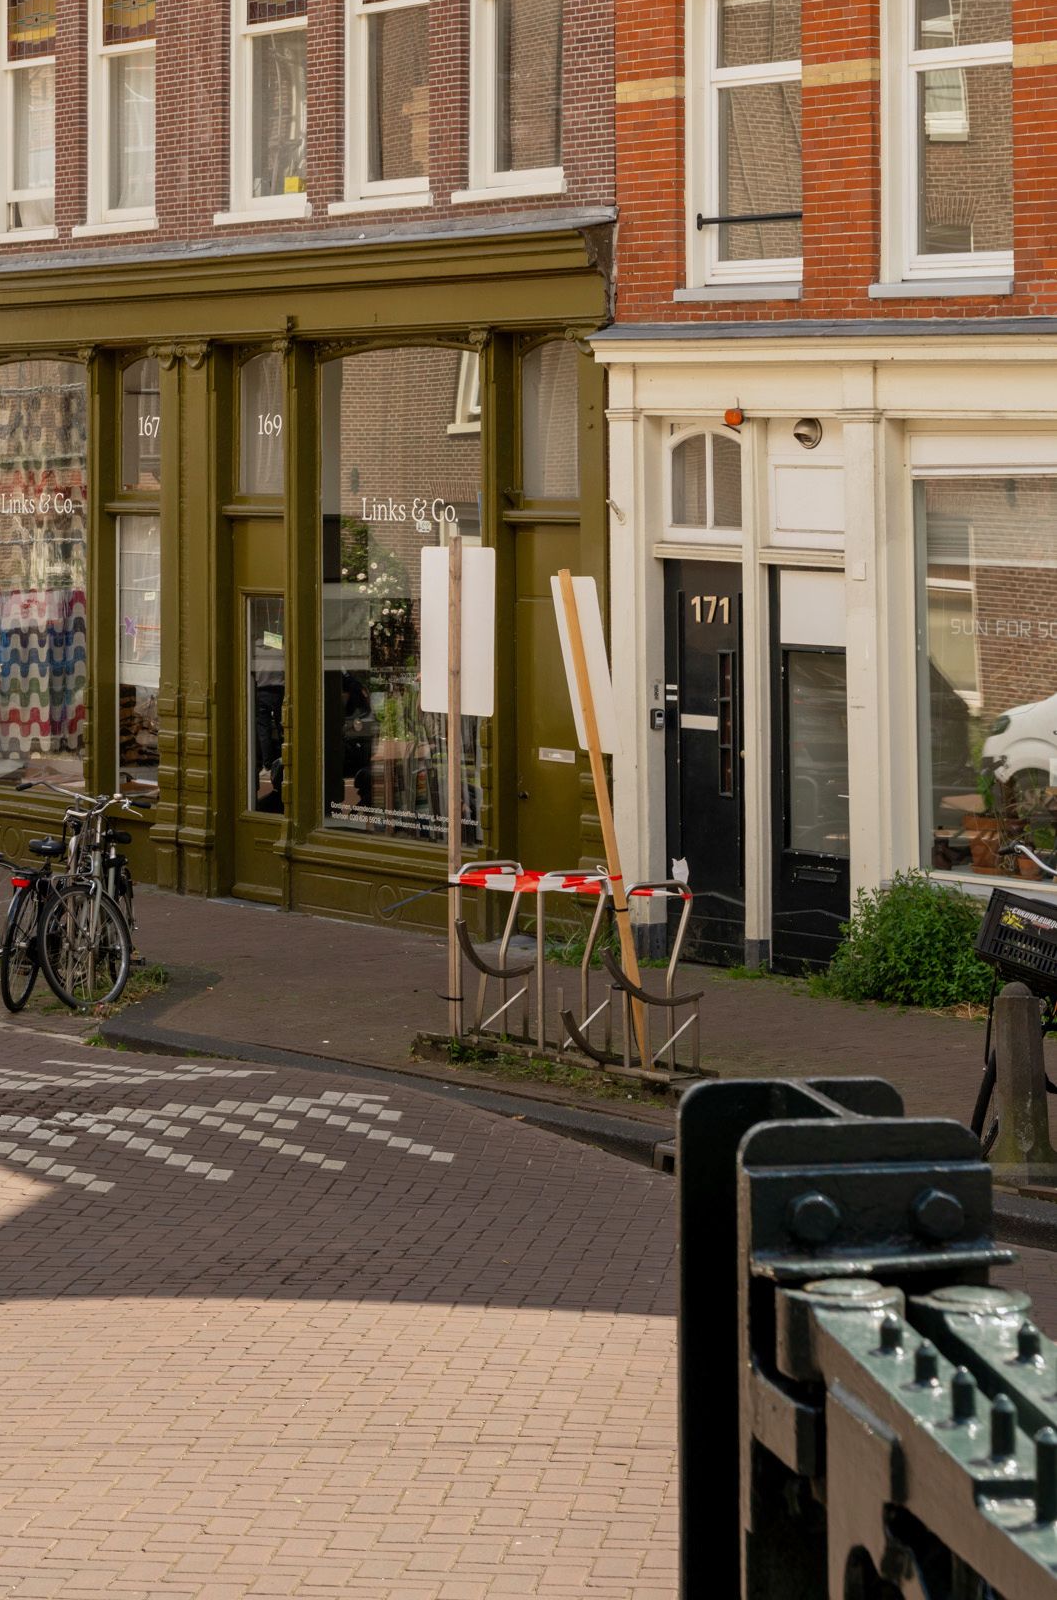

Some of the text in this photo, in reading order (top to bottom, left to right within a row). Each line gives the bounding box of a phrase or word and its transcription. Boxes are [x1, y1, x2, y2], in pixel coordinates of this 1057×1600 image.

[139, 415, 160, 438] 167
[258, 413, 282, 437] 169
[1, 492, 75, 514] Links & Co.
[362, 497, 458, 522] Links & Co.
[691, 595, 730, 624] 171
[951, 618, 988, 636] SUN
[996, 620, 1031, 638] FOR
